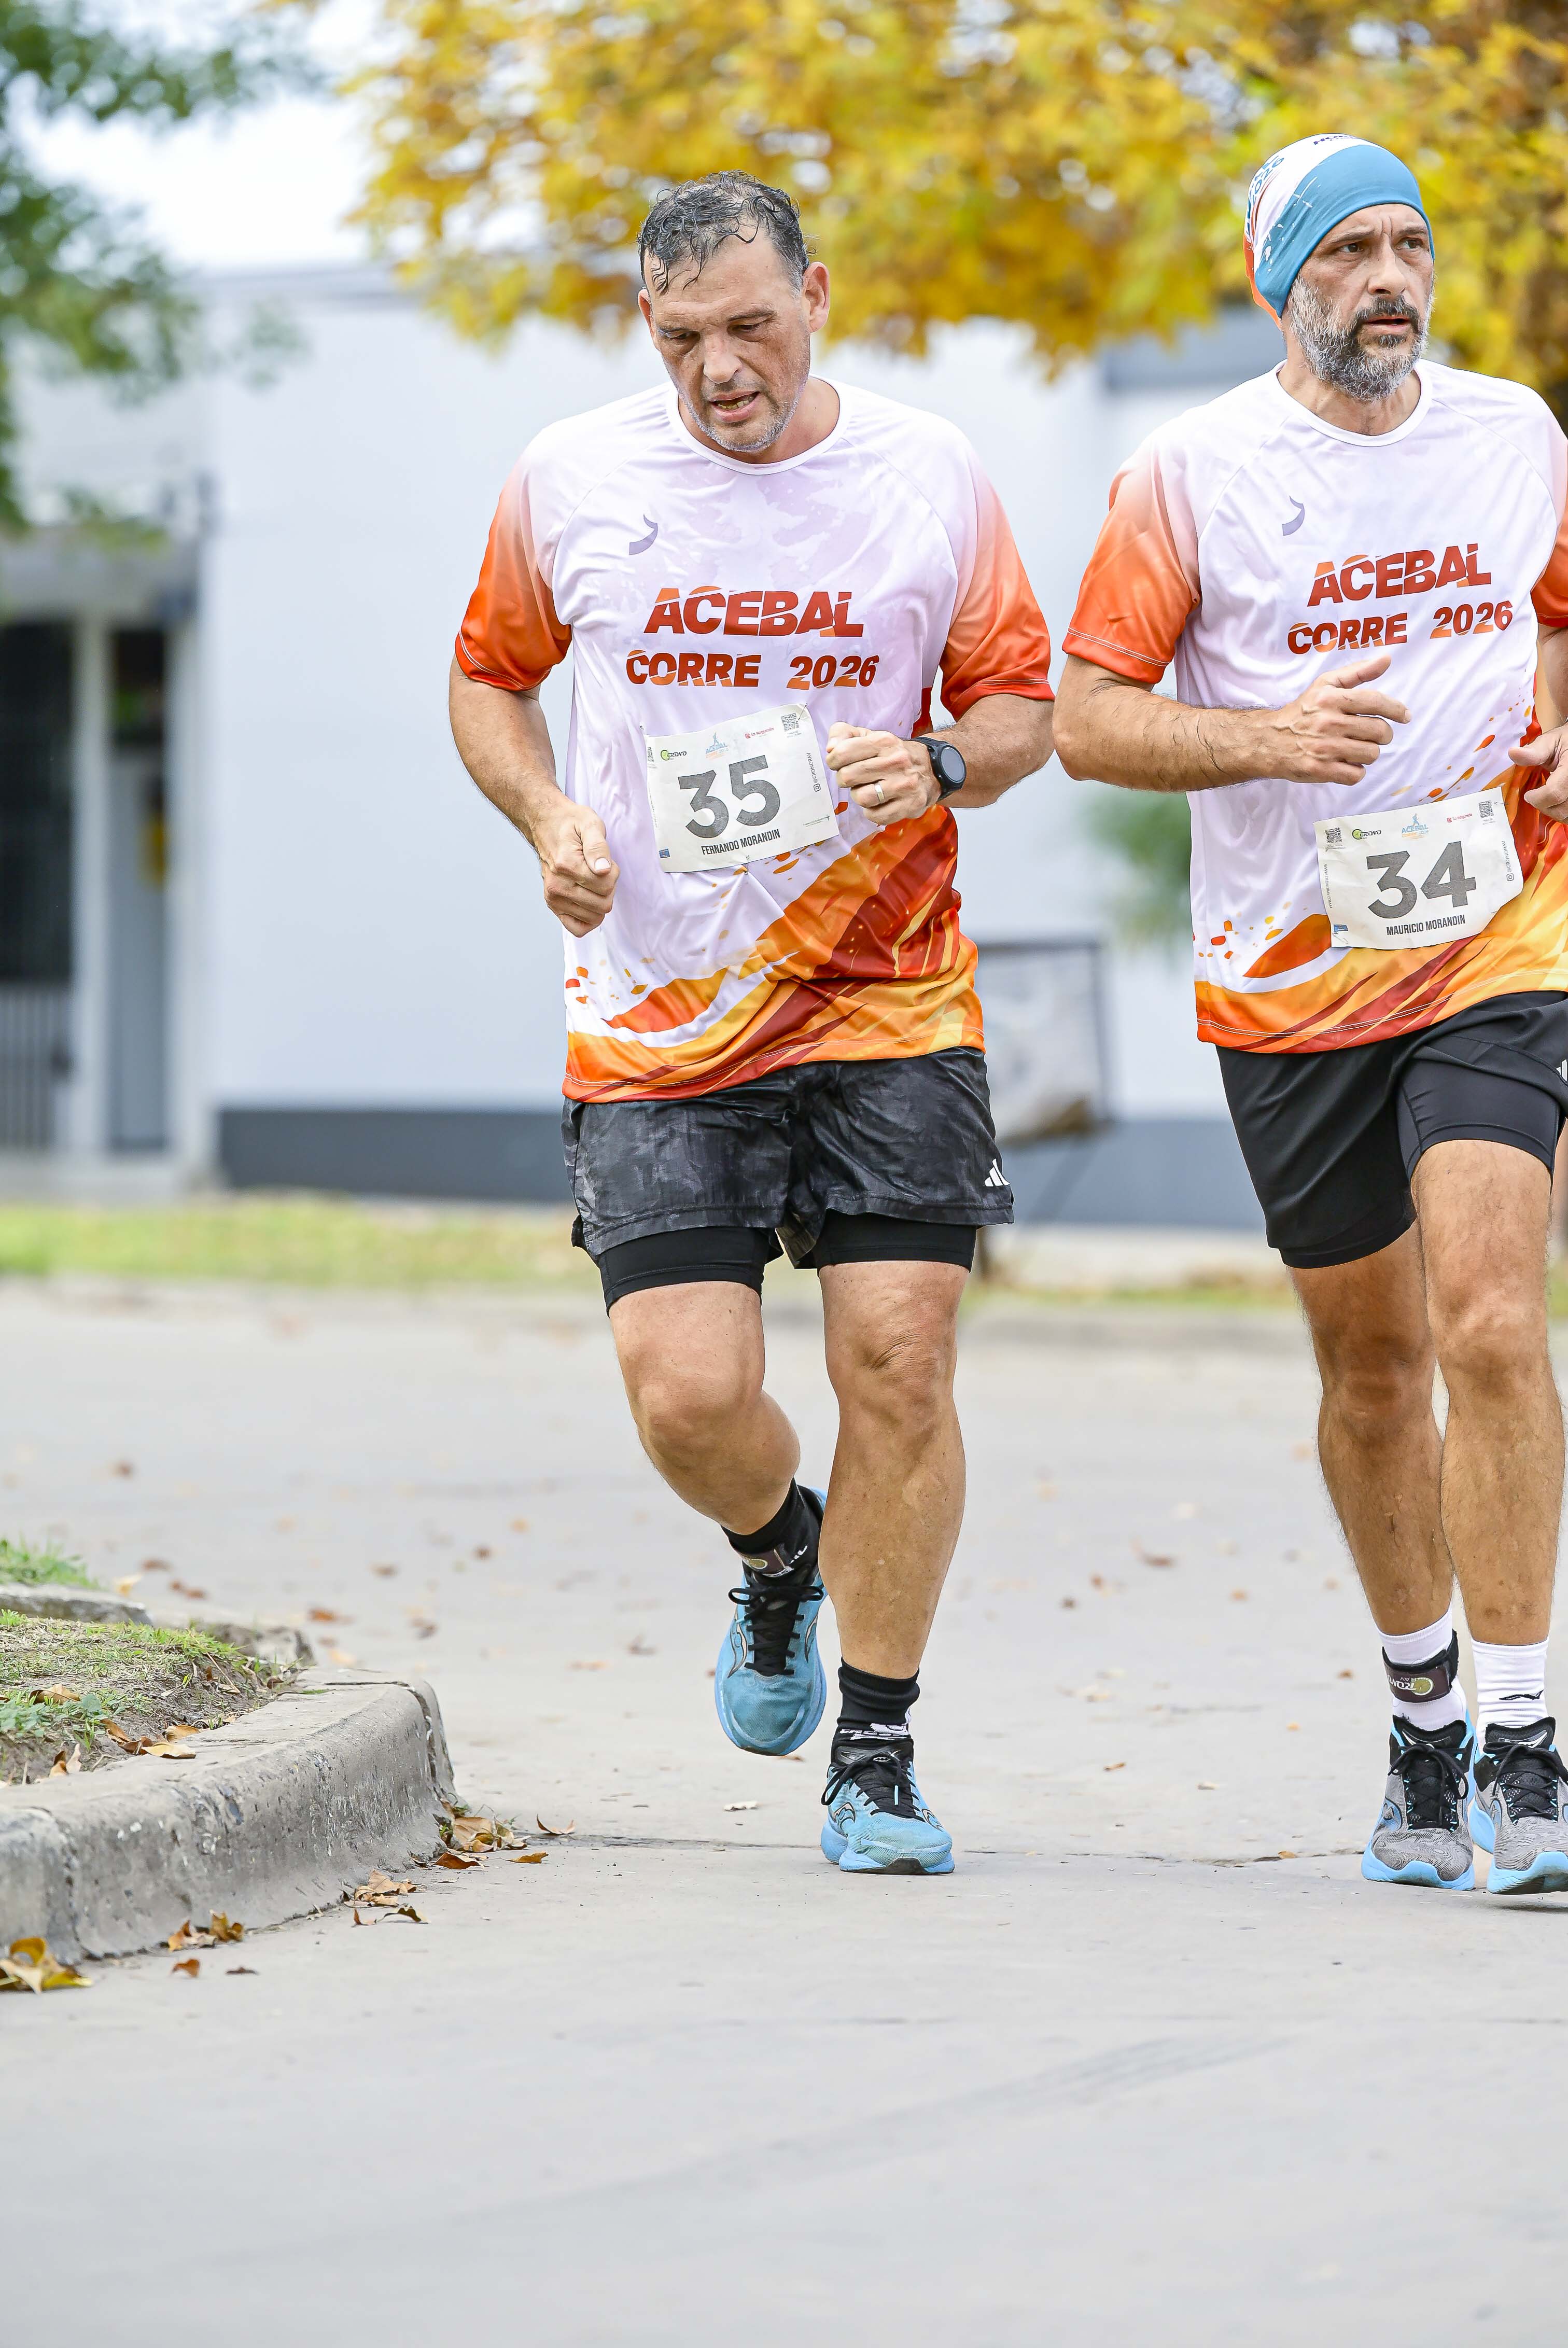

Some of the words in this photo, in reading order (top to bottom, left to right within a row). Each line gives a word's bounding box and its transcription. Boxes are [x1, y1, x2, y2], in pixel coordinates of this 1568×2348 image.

[1307, 543, 1491, 607] ACEBAL
[643, 585, 864, 637] ACEBAL
[1287, 612, 1407, 654] CORRE
[1430, 600, 1513, 639] 2026
[626, 649, 761, 687] CORRE
[786, 654, 879, 690] 2026
[677, 755, 780, 838] 35
[701, 840, 739, 855] FERNANDO
[739, 829, 780, 848] MORANDIN
[1366, 841, 1477, 919] 34
[1386, 923, 1424, 935] MAURICIO
[1425, 914, 1465, 931] MORANDIN
